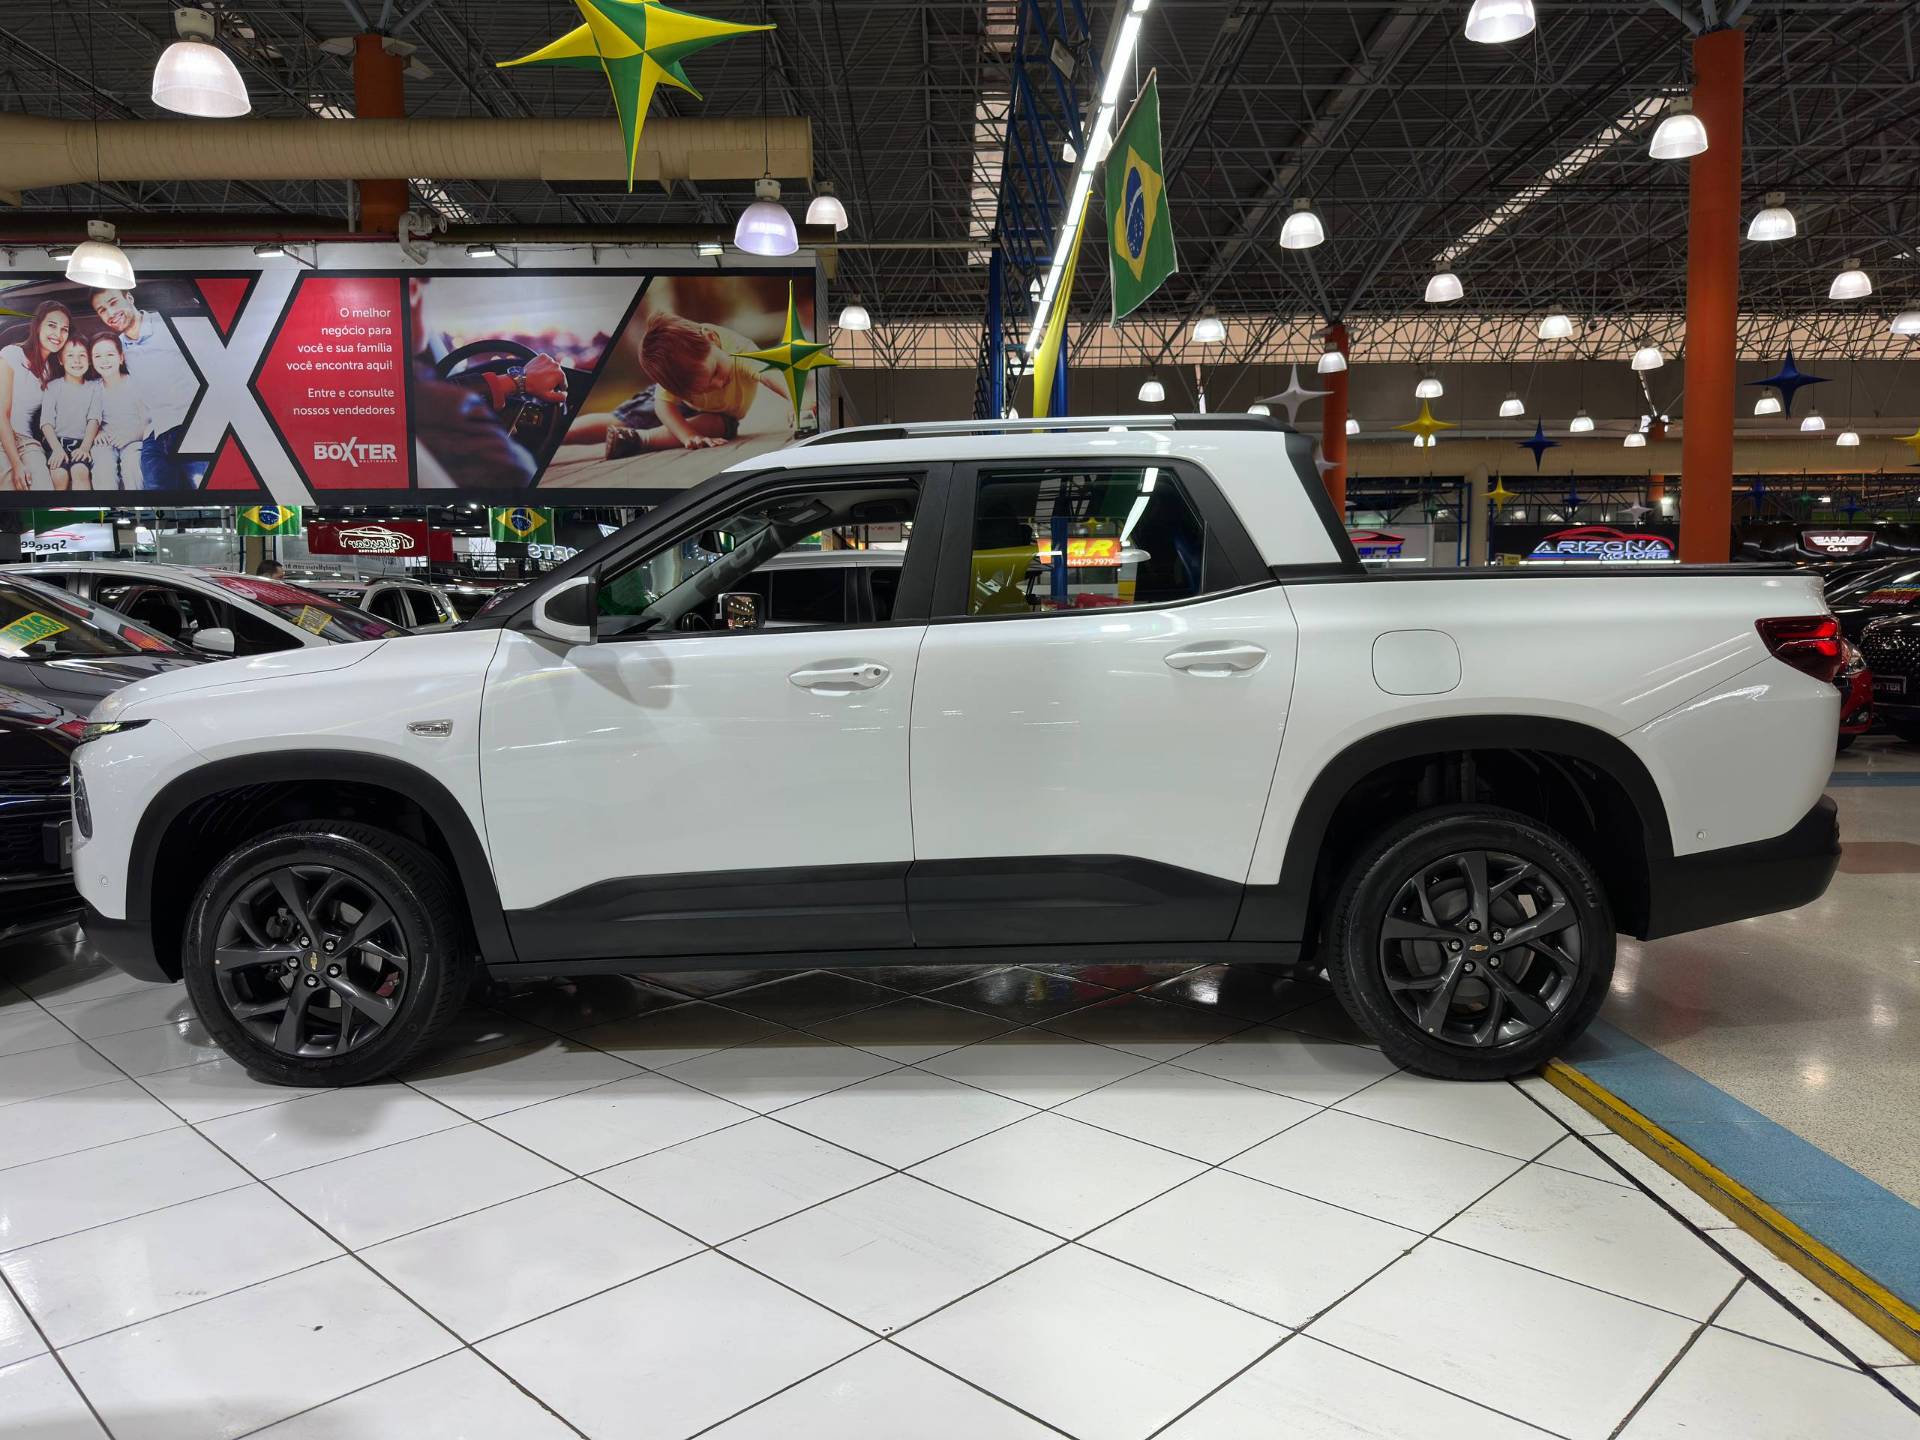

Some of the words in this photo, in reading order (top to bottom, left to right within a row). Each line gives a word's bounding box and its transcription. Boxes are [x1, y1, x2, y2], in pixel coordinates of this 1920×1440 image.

[340, 307, 350, 318] O
[352, 307, 391, 318] melhor
[321, 326, 365, 337] negócio
[368, 327, 392, 337] para
[297, 343, 324, 353] você
[326, 345, 333, 353] e
[335, 345, 354, 353] sua
[356, 343, 392, 353] família
[286, 361, 312, 370] você
[315, 361, 364, 370] encontra
[366, 360, 393, 372] aqui!
[307, 388, 337, 398] Entre
[338, 390, 346, 398] e
[348, 388, 395, 398] consulte
[293, 408, 330, 416] nossos
[332, 405, 395, 415] vendedores
[313, 437, 397, 467] BOXTER
[1532, 540, 1670, 554] ARIZONA
[1598, 551, 1669, 560] MOTORS
